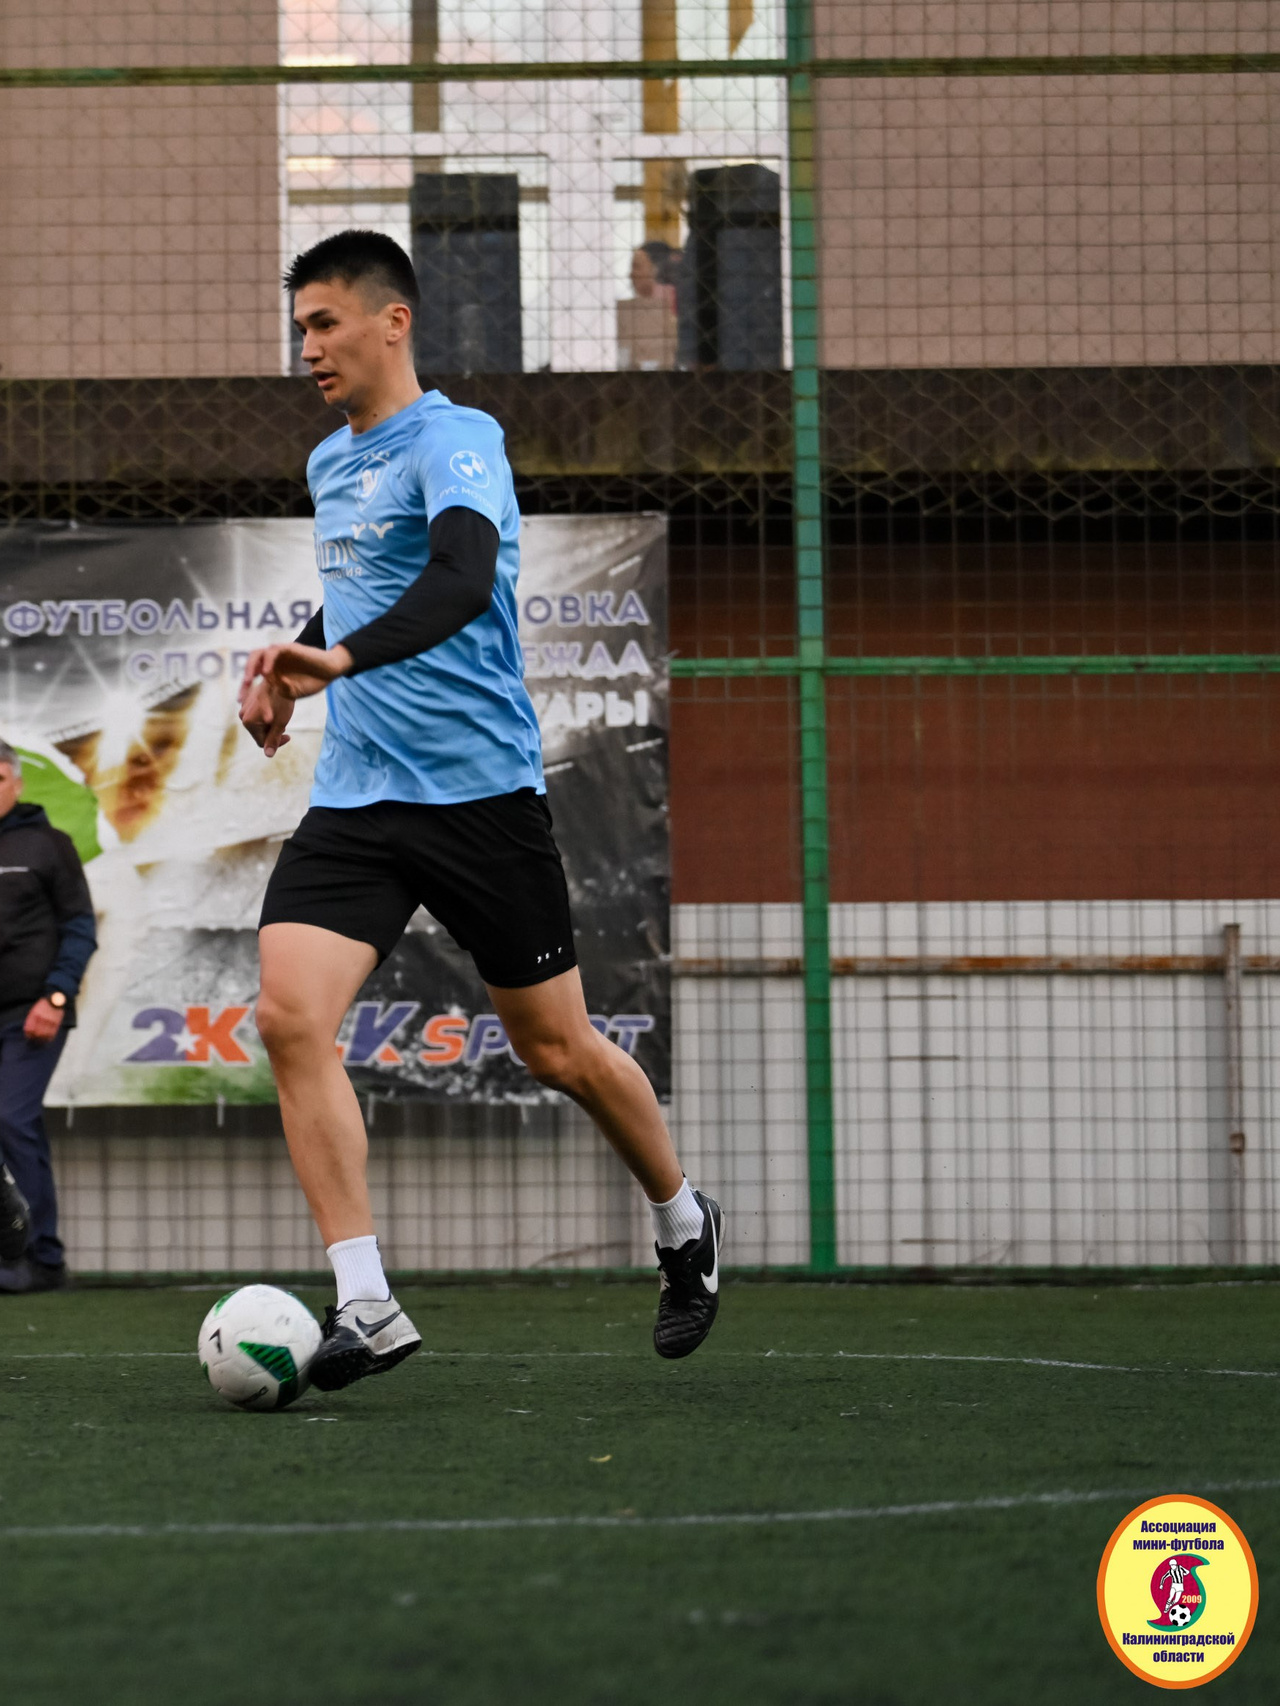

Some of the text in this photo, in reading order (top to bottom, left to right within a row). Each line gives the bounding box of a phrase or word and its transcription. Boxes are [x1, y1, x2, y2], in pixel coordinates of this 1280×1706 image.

[4, 589, 650, 636] ФУТБОЛЬНАЯ ОВКА
[127, 640, 652, 682] СПОР ЕЖДА
[123, 1005, 253, 1065] 2K
[420, 1015, 655, 1066] SPT
